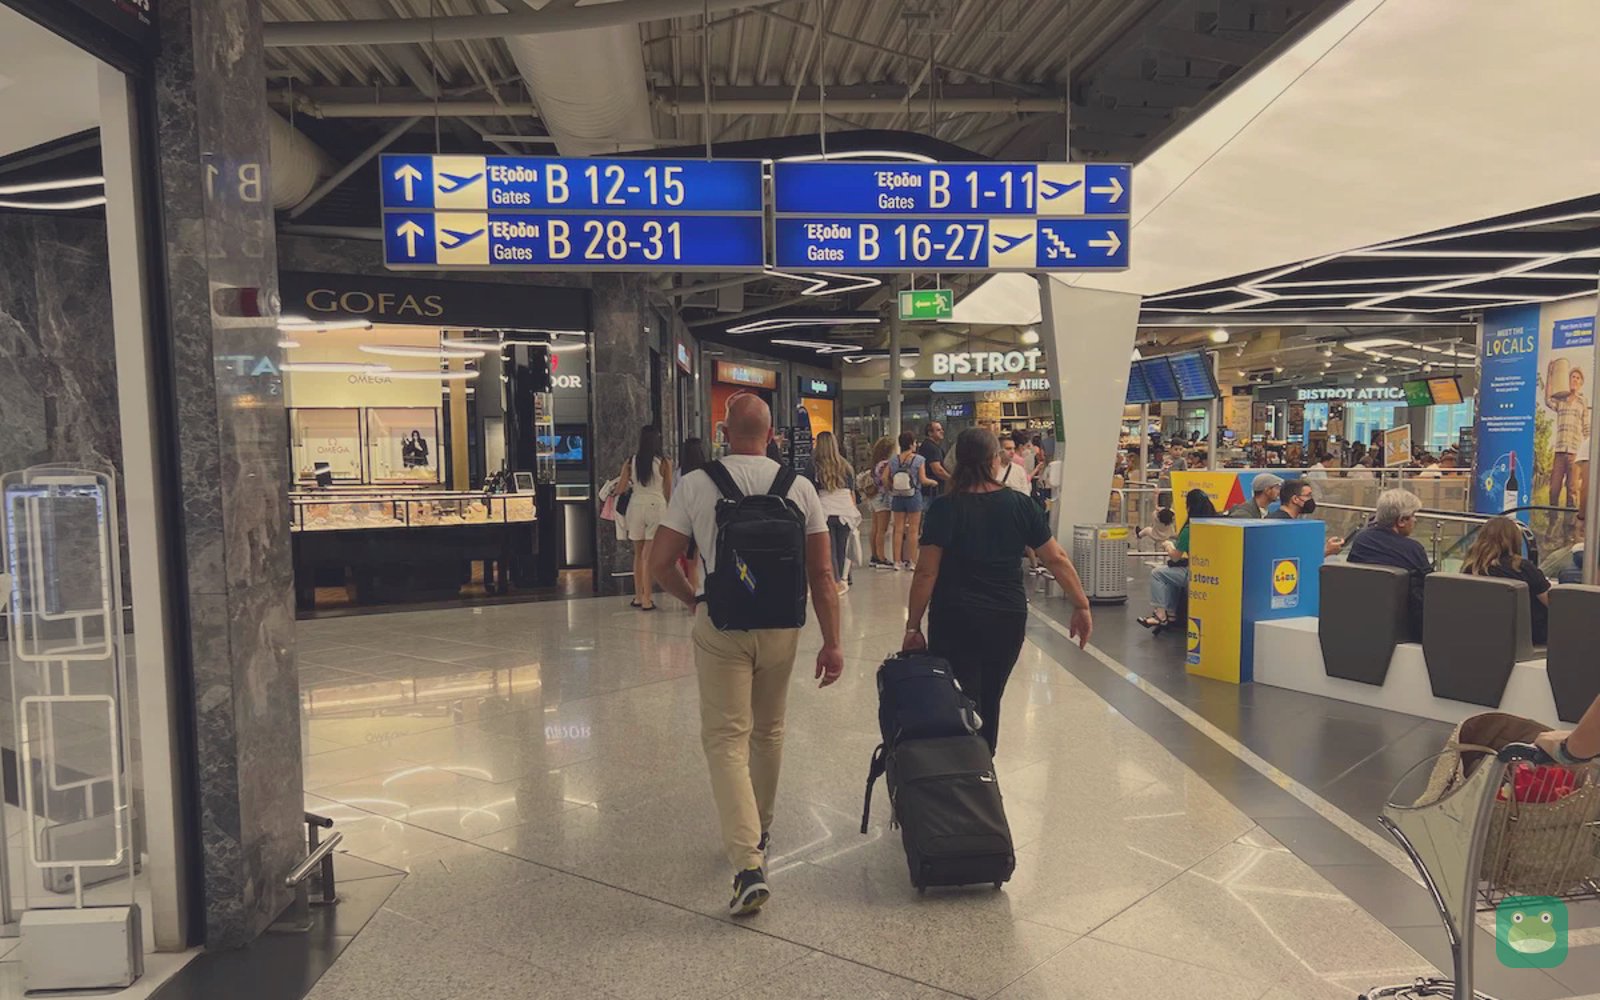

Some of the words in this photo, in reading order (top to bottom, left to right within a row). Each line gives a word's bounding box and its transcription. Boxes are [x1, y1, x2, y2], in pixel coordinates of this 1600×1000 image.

[546, 164, 569, 204] B
[585, 166, 684, 206] 12-15
[929, 170, 951, 209] B
[965, 171, 1034, 209] 1-11
[492, 188, 530, 204] Gates
[878, 194, 914, 209] Gates
[549, 220, 571, 260] B
[584, 220, 681, 260] 28-31
[859, 224, 880, 261] B
[894, 223, 985, 261] 16-27
[494, 245, 532, 261] Gates
[808, 246, 844, 261] Gates
[305, 288, 444, 316] GOFAS
[1486, 335, 1535, 357] LOCALS
[933, 351, 1041, 374] BISTROT
[347, 374, 392, 384] OMEGA
[1297, 388, 1355, 400] BISTROT
[317, 446, 350, 454] OMEGA
[1193, 573, 1219, 585] stores
